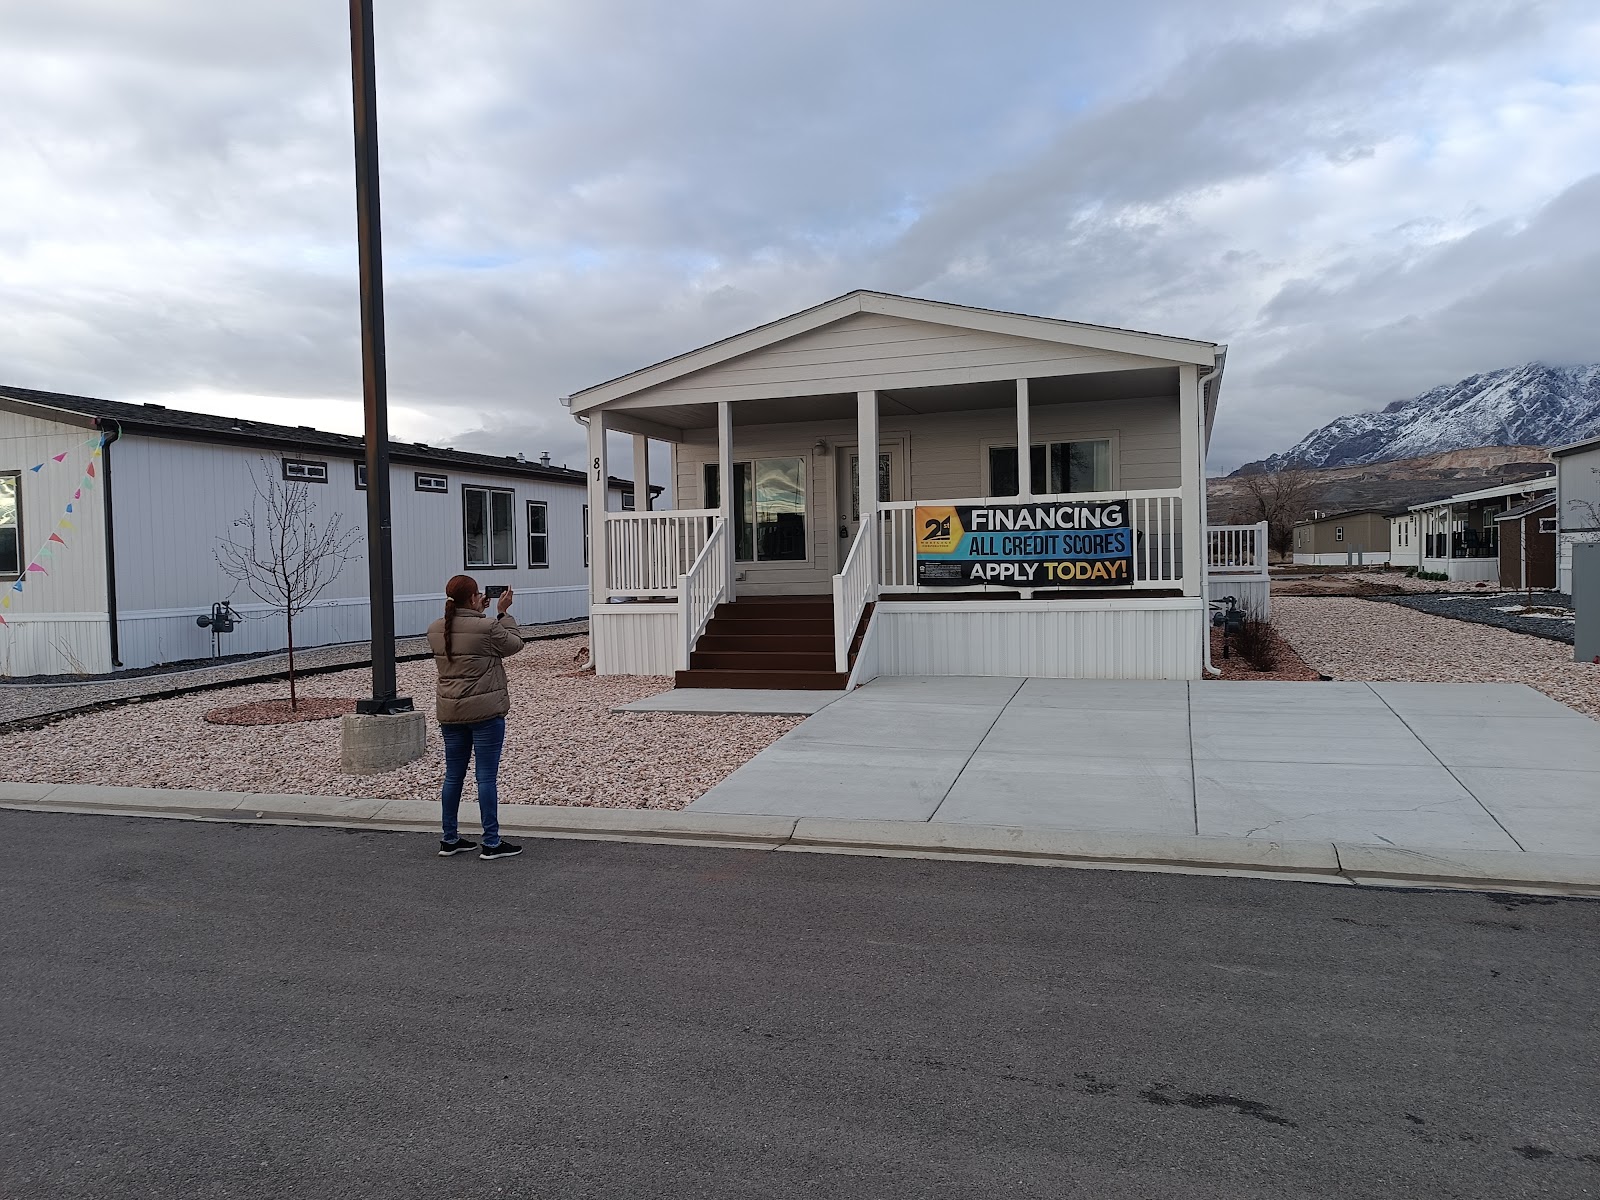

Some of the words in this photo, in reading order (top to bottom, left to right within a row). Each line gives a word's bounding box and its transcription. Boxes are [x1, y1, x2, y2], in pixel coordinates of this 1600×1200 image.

[593, 457, 601, 482] 81
[971, 505, 1123, 531] FINANCING
[969, 536, 999, 556] ALL
[1002, 534, 1060, 555] CREDIT
[1062, 532, 1126, 554] SCORES
[969, 562, 1039, 581] APPLY
[1043, 560, 1127, 580] TODAY!
